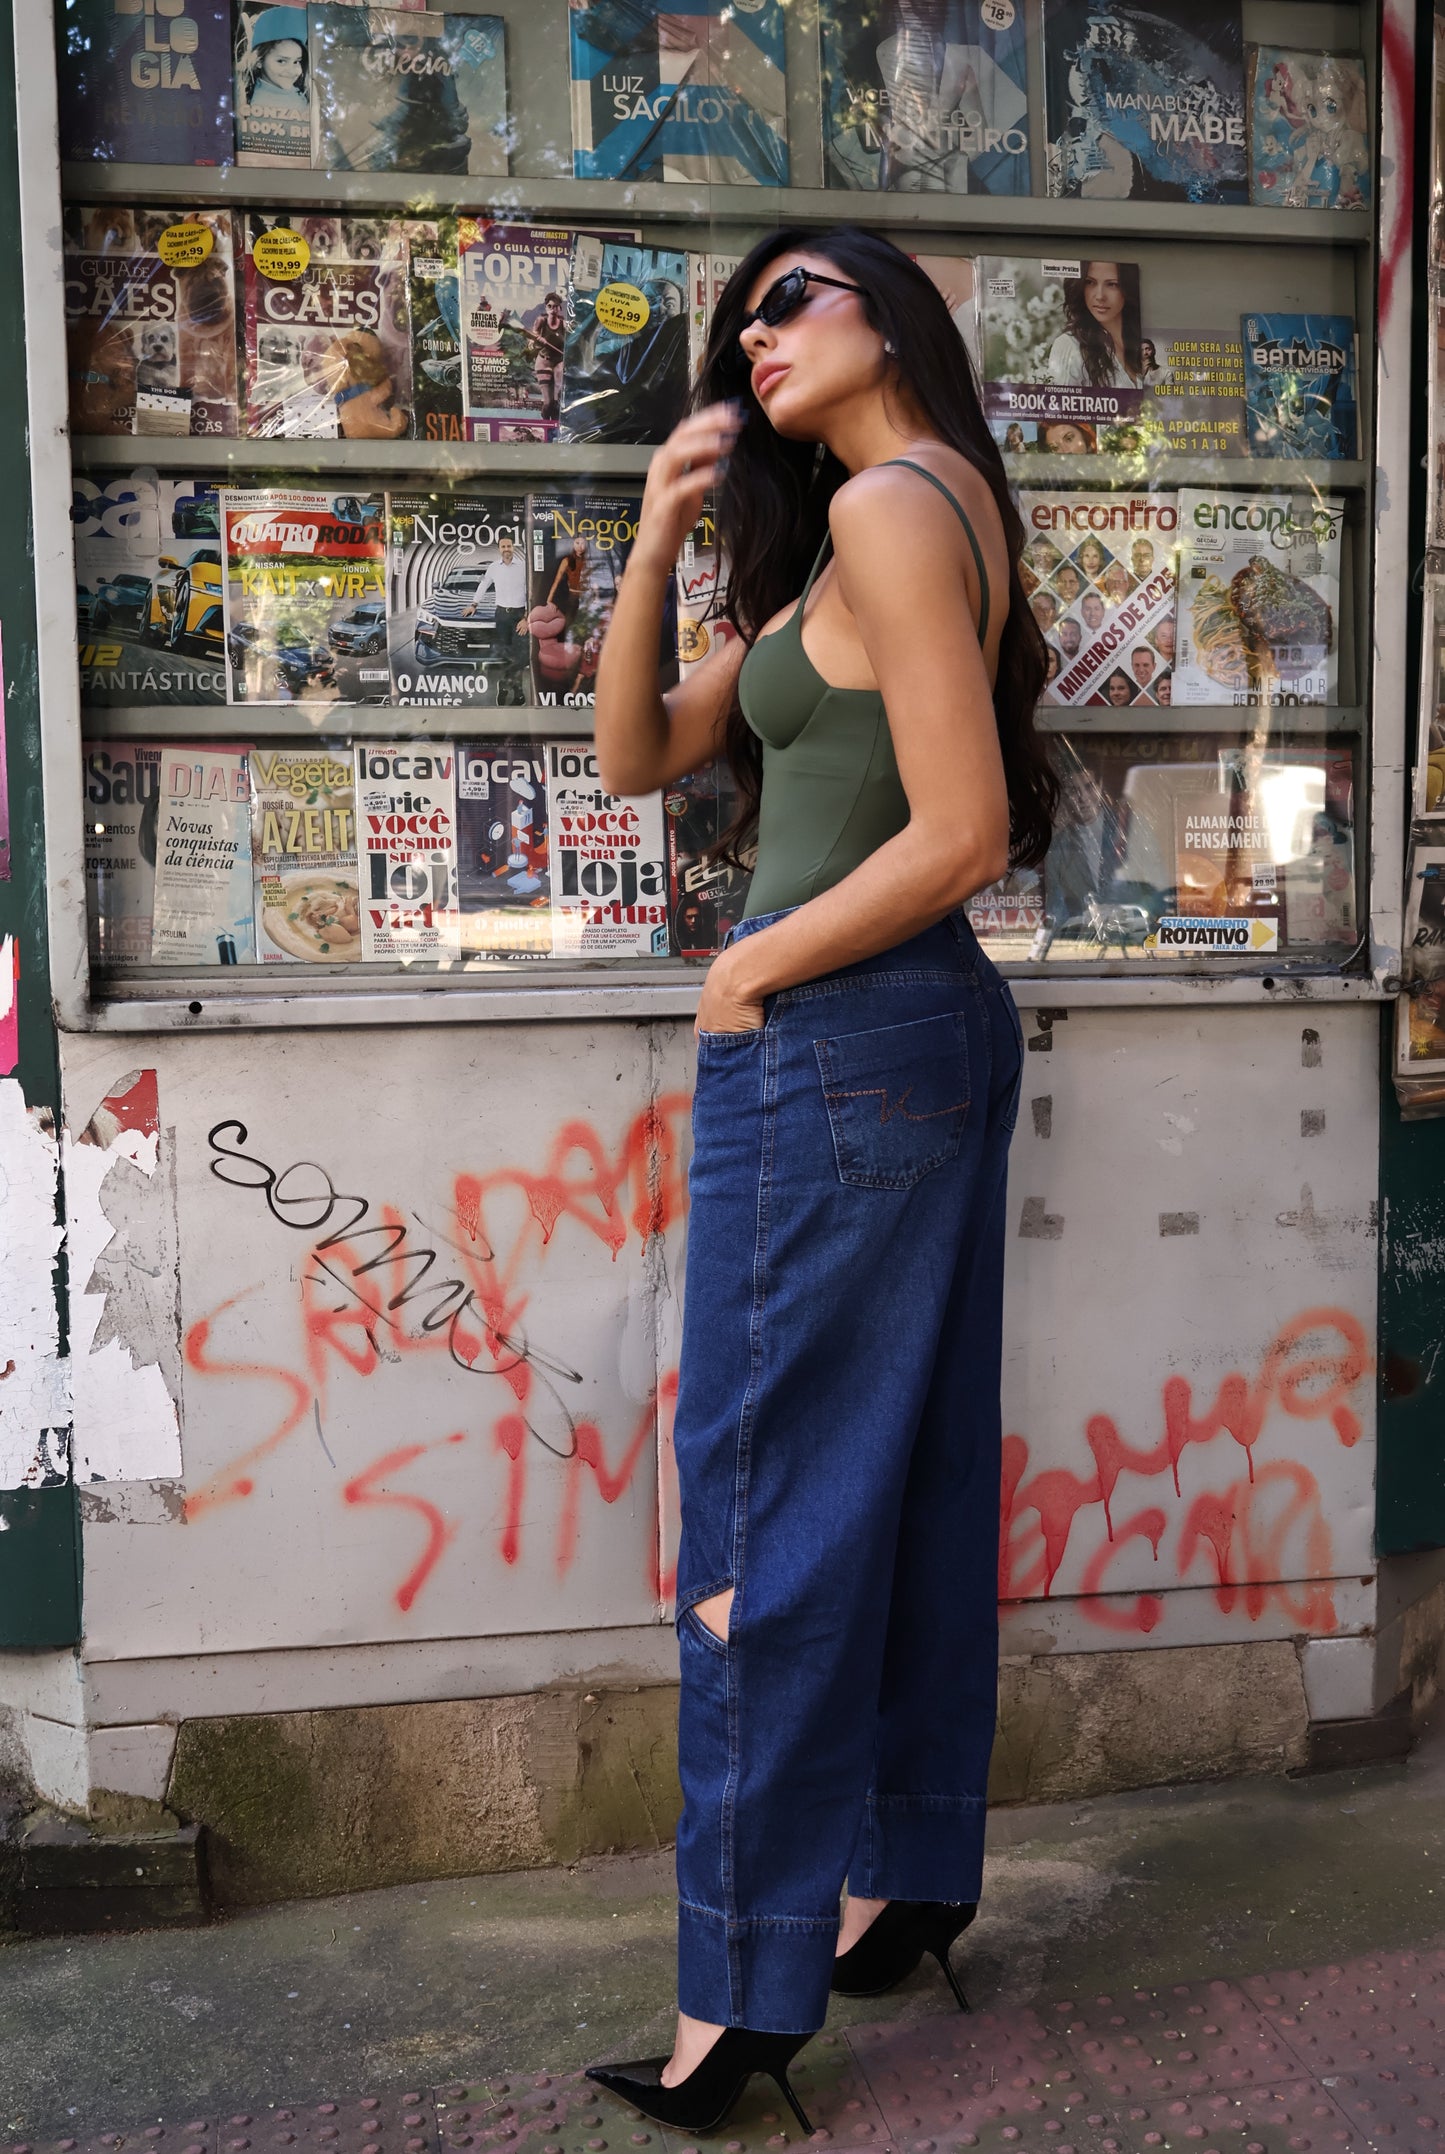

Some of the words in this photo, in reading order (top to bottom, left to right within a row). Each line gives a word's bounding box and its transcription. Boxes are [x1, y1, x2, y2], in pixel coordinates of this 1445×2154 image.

[145, 17, 199, 54] LO
[130, 52, 201, 90] GIA
[602, 75, 644, 94] LUIZ
[1105, 92, 1190, 112] MANABU
[241, 120, 286, 136] 100%
[1150, 113, 1246, 145] MABE
[493, 242, 501, 251] O
[504, 243, 531, 253] GUIA
[80, 260, 132, 277] GUIA
[270, 260, 301, 270] 19,99
[339, 275, 355, 286] DE
[65, 277, 175, 318] CÃES
[466, 281, 546, 302] BATTLE
[264, 284, 380, 325] CÃES
[610, 297, 630, 306] LUVA
[610, 307, 640, 322] 12,99
[470, 320, 498, 329] OFICIAIS
[422, 339, 444, 351] COMO
[1200, 342, 1221, 353] SERA
[471, 356, 510, 365] TESTAMOS
[1168, 356, 1201, 367] METADE
[1203, 357, 1214, 367] DO
[1216, 358, 1232, 368] FIM
[1253, 348, 1346, 366] BATMAN
[471, 365, 482, 373] OS
[483, 365, 507, 373] MITOS
[1175, 371, 1194, 381] DIAS
[1196, 371, 1201, 381] E
[1203, 371, 1224, 382] MEIO
[1226, 372, 1237, 382] DA
[1044, 386, 1075, 394] FOTOGRAFIA
[1154, 385, 1171, 396] QUE
[1173, 385, 1184, 396] HA
[1189, 386, 1199, 396] DE
[1202, 386, 1216, 396] VIR
[1217, 386, 1245, 397] SOBRE
[1009, 393, 1046, 410] BOOK
[1048, 395, 1059, 411] &
[1061, 396, 1119, 413] RETRATO
[1169, 421, 1239, 434] APOCALIPSE
[1172, 438, 1187, 449] VS
[1191, 438, 1197, 449] 1
[1201, 438, 1209, 450] A
[1213, 438, 1227, 450] 18
[1136, 499, 1148, 507] BH
[392, 516, 414, 526] veja
[532, 511, 554, 522] veja
[1031, 499, 1177, 532] encontro
[230, 522, 319, 546] QUATRO
[342, 565, 370, 574] HONDA
[241, 571, 301, 597] KAIT
[1056, 622, 1126, 701] MINEIROS
[1117, 602, 1145, 631] DE
[79, 666, 227, 692] FANTÁSTICO
[397, 674, 412, 693] O
[415, 674, 488, 698] AVANÇO
[1252, 677, 1327, 693] MELHOR
[262, 799, 284, 810] DOSSIÊ
[284, 801, 294, 810] DO
[370, 791, 432, 813] rie
[166, 816, 213, 834] Novas
[366, 808, 451, 834] você
[560, 805, 640, 831] você
[1186, 816, 1259, 829] ALMANAQUE
[262, 809, 357, 854] AZEIT
[165, 835, 239, 855] conquistas
[367, 836, 452, 850] mesmo
[558, 834, 641, 847] mesmo
[164, 850, 183, 867] da
[186, 852, 234, 870] ciência
[580, 850, 615, 860] sua
[366, 852, 459, 910] loj
[557, 850, 666, 909] loja
[971, 891, 1043, 909] GUARDIÕES
[1161, 918, 1249, 928] ESTACIONAMENTO
[1160, 927, 1249, 945] ROTATIVO
